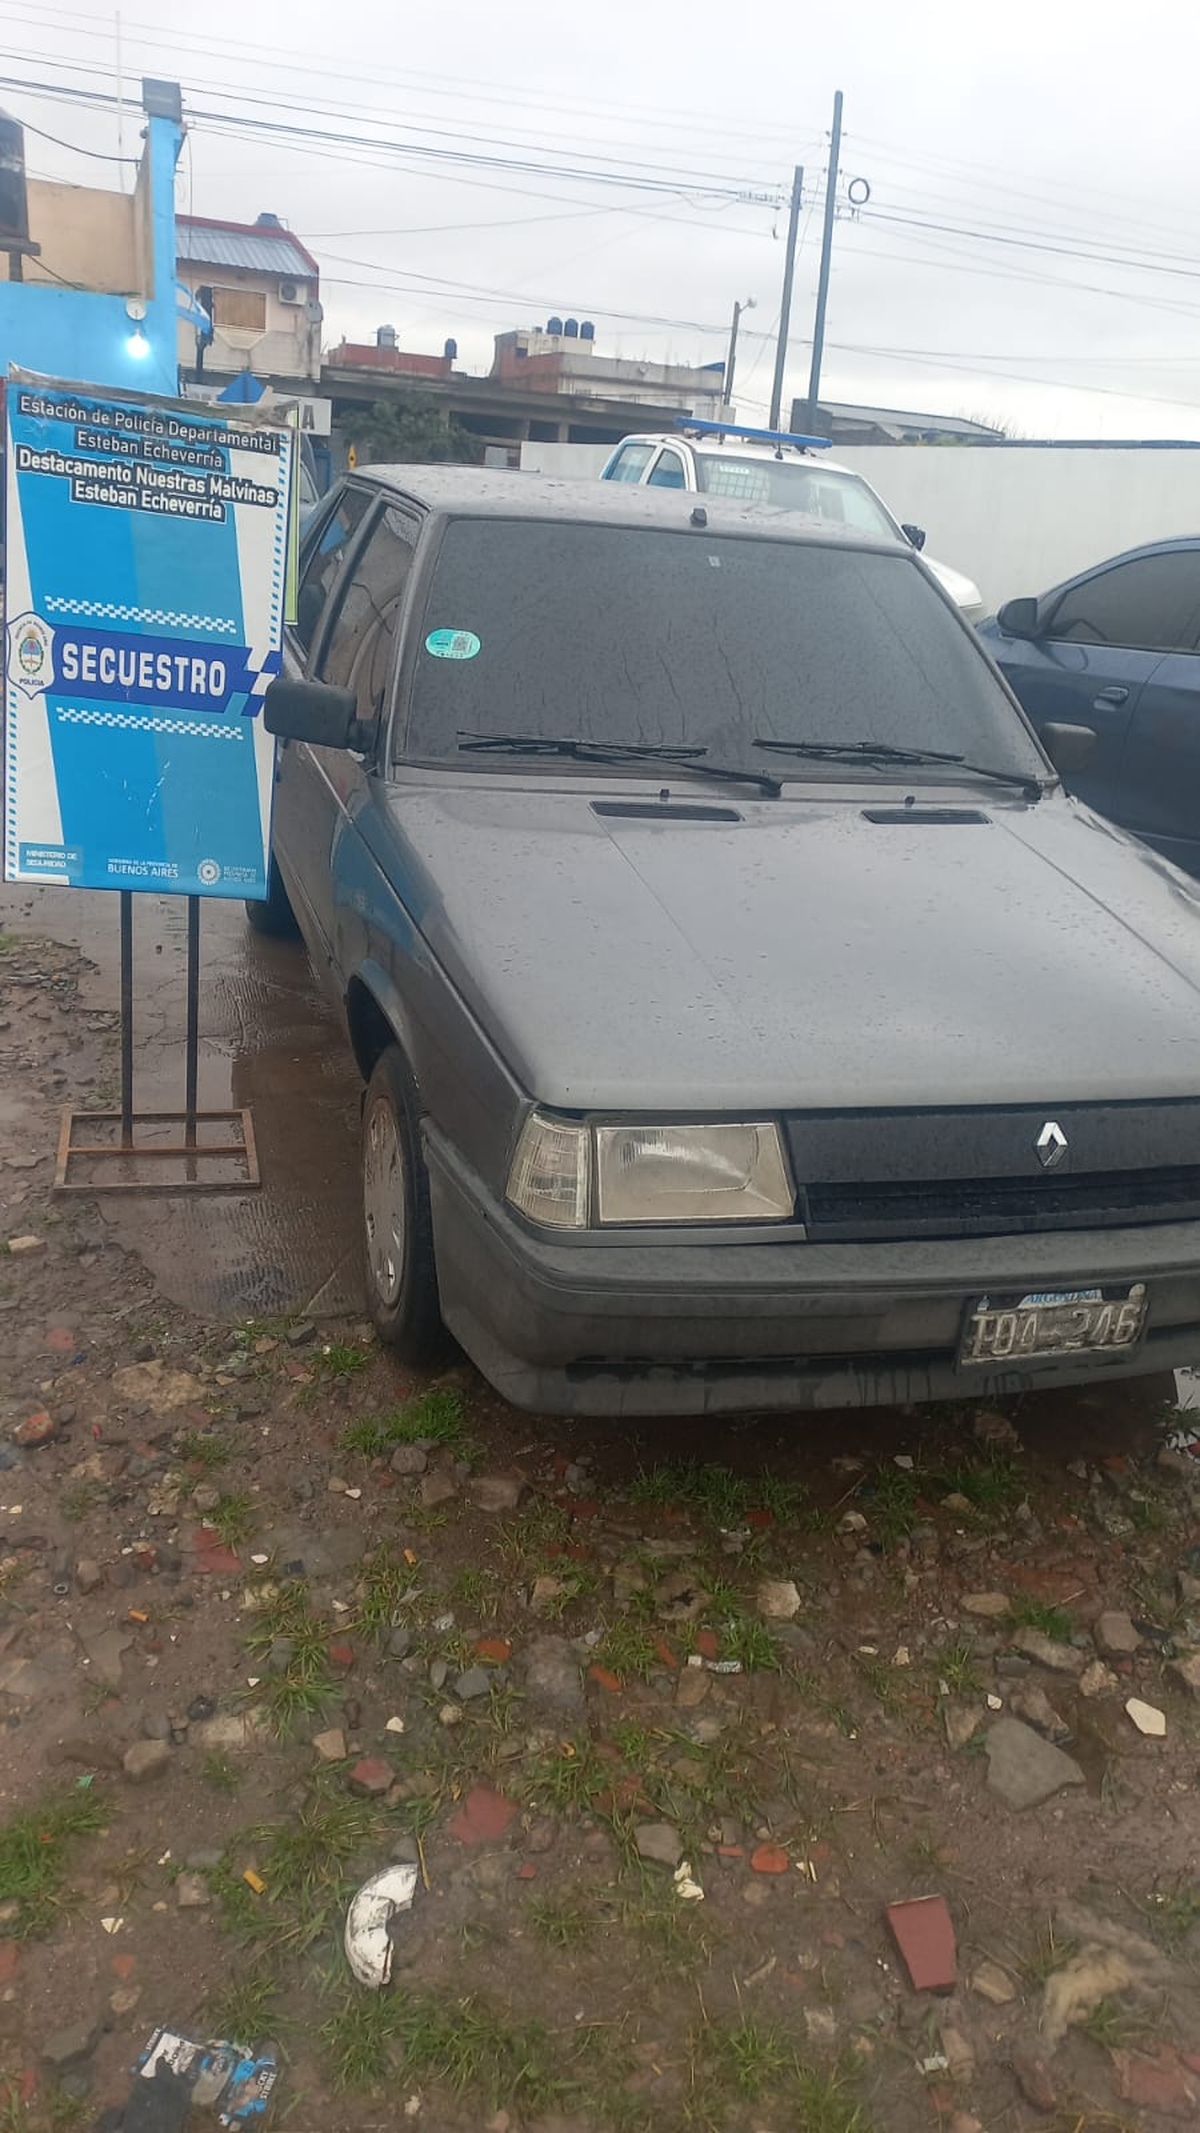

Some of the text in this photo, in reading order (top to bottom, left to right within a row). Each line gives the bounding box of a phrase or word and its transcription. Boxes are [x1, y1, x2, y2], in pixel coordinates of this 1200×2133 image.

[20, 395, 277, 451] Estación de Policía Departamental
[78, 431, 223, 468] Esteban Echeverría
[19, 450, 275, 505] Destacamento Nuestras Malvinas
[75, 480, 223, 519] Esteban Echeverría
[61, 642, 227, 697] SECUESTRO
[107, 863, 179, 878] BUENOS AIRES
